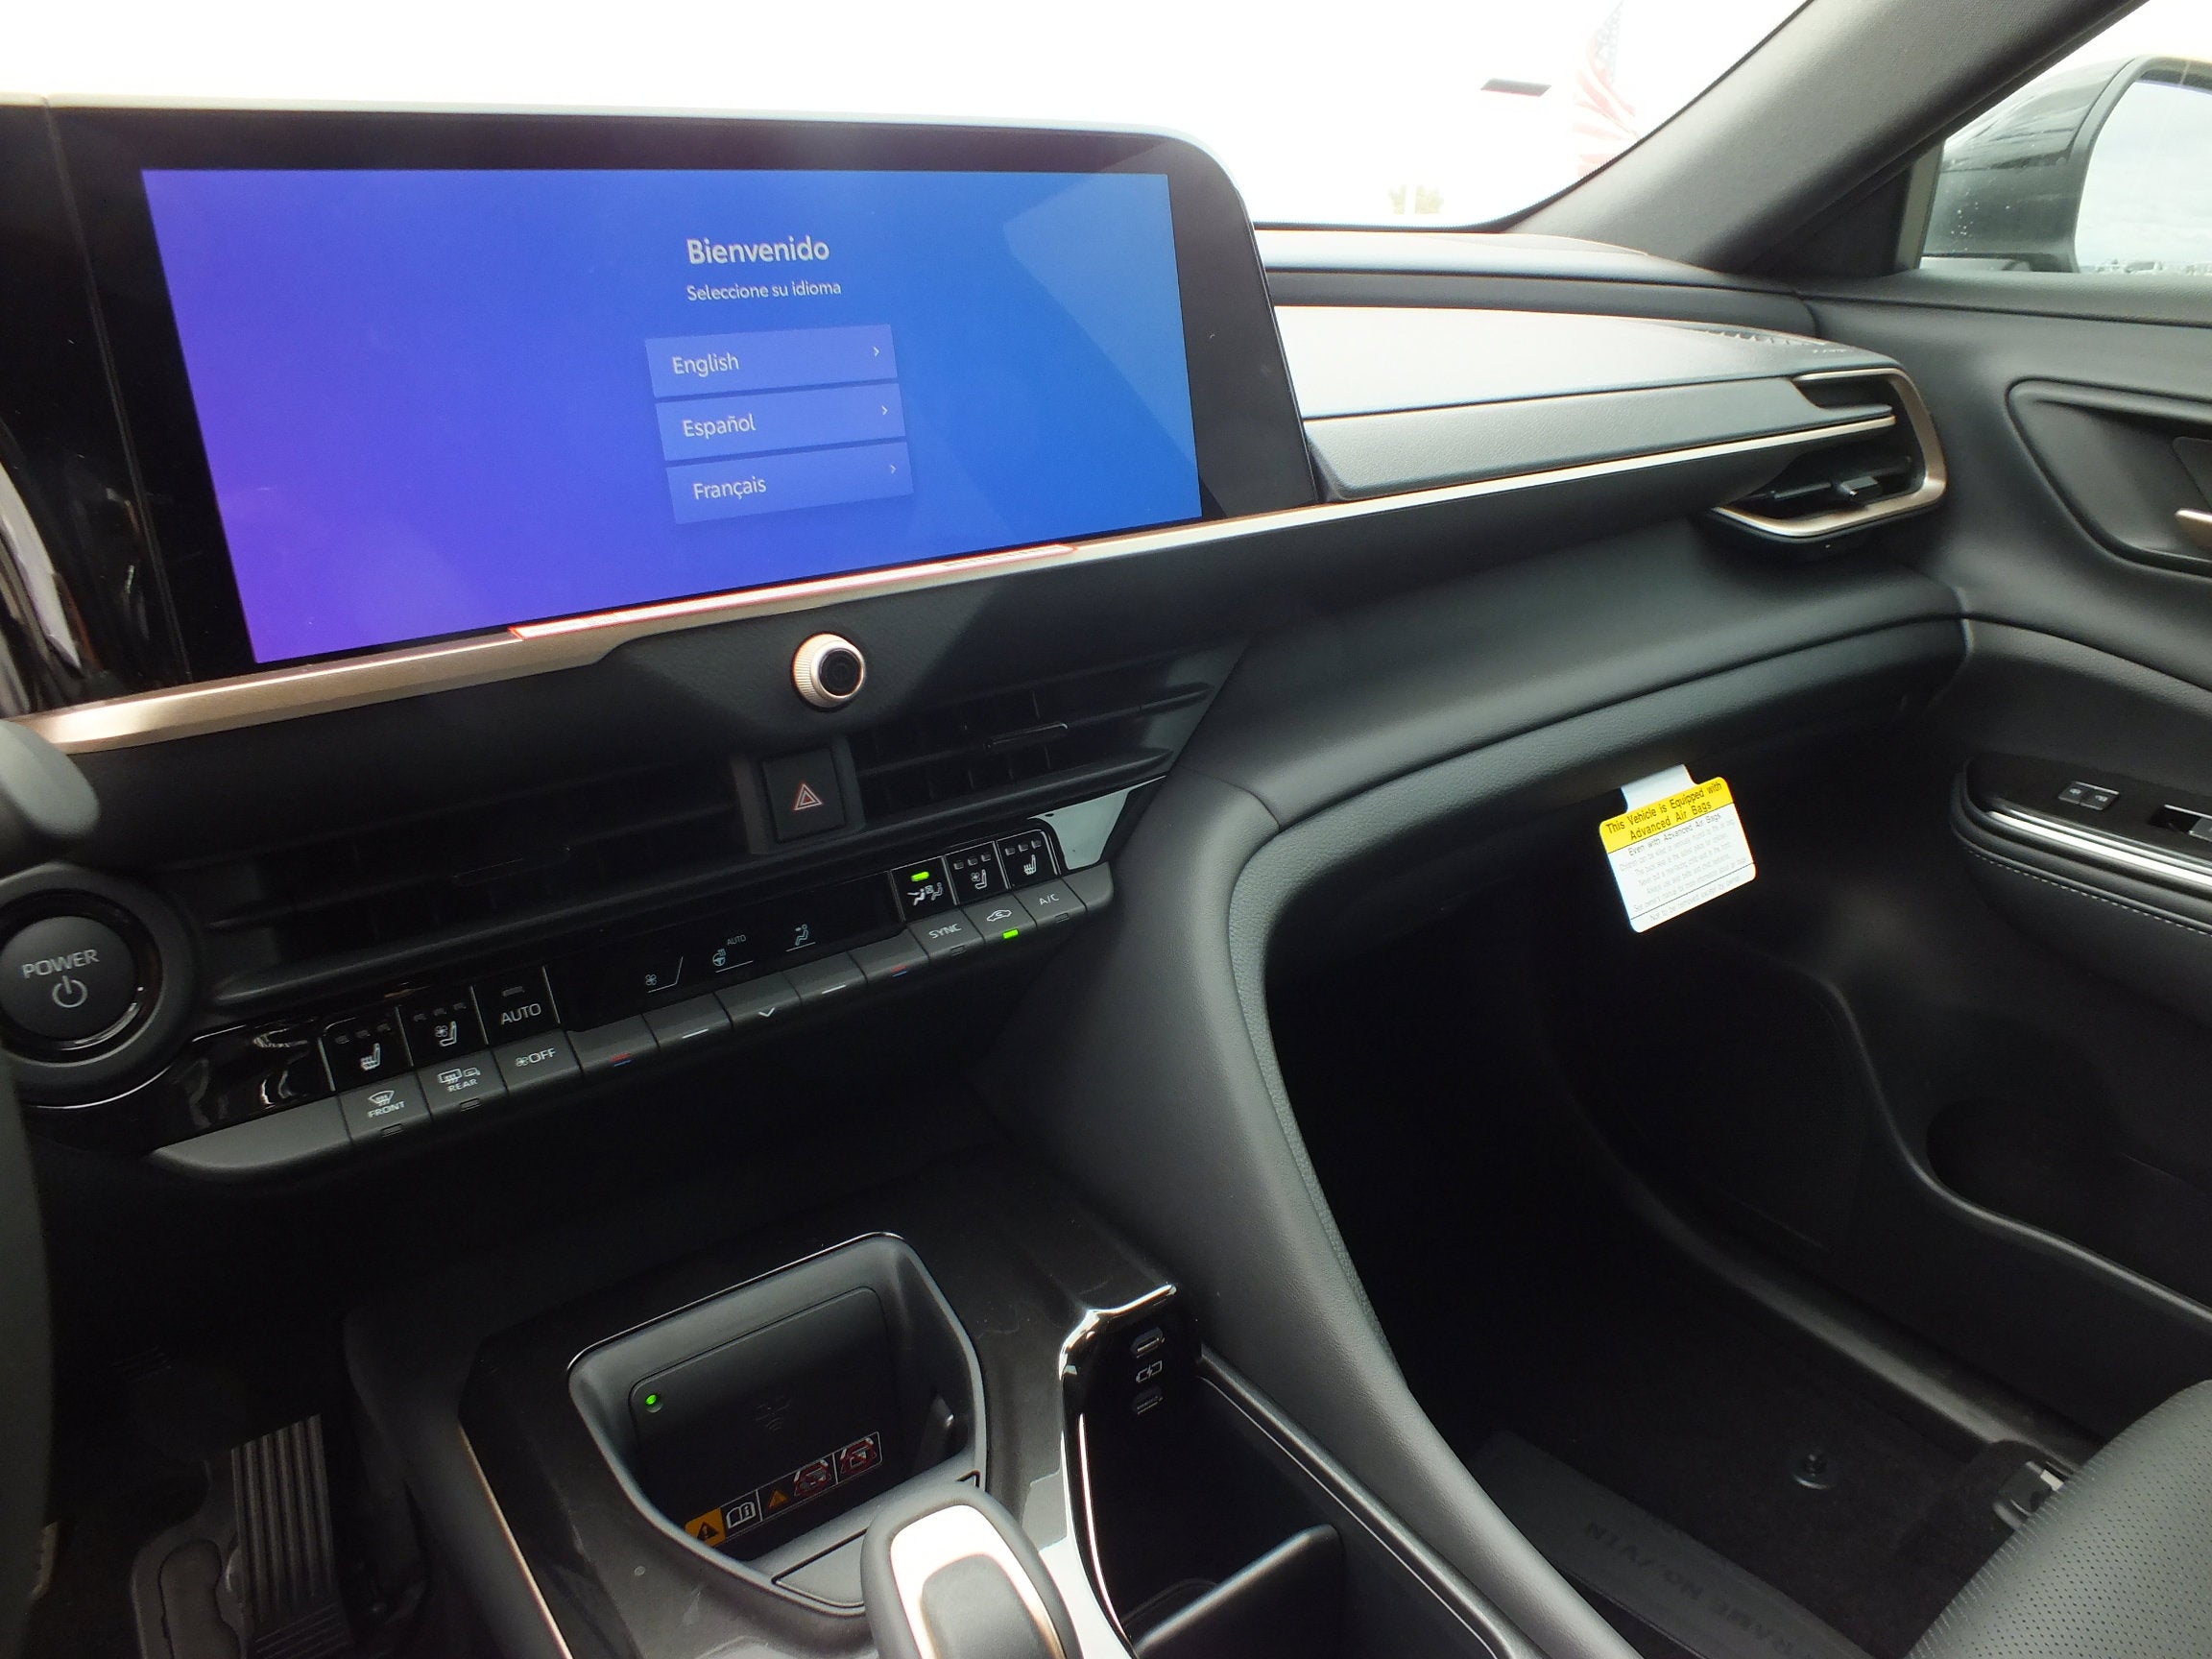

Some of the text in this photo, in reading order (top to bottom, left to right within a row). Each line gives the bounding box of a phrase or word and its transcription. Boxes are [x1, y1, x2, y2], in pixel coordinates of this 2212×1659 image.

[685, 235, 830, 266] Bienvenido
[686, 280, 842, 301] Seleccione su idioma
[672, 352, 740, 377] English
[683, 414, 757, 439] Español
[693, 476, 767, 499] Français
[1606, 781, 1722, 834] This Vehicle is Equipped with
[1629, 800, 1712, 841] Advanced Air Bags
[1627, 844, 1645, 856] Even
[1647, 837, 1661, 849] with
[1664, 825, 1694, 841] Advanced
[1038, 892, 1060, 906] A/C
[726, 933, 747, 947] AUTO
[928, 923, 962, 940] SYNC
[21, 948, 100, 979] POWER
[499, 1001, 542, 1026] AUTO
[528, 1046, 556, 1068] OFF
[446, 1076, 478, 1094] REAR
[367, 1099, 406, 1118] FRONT
